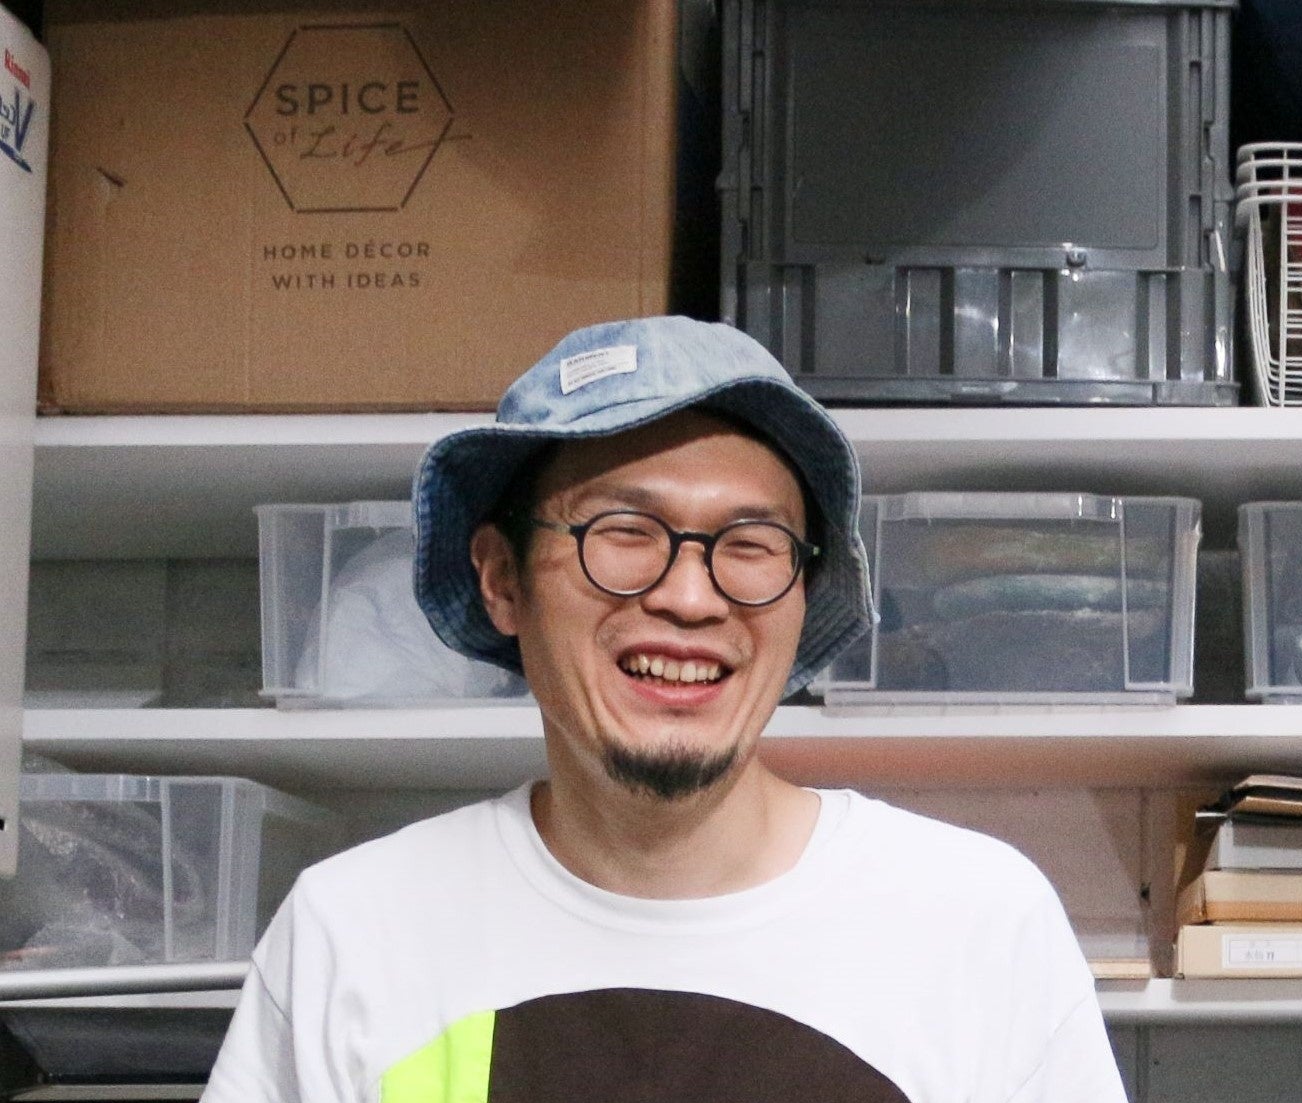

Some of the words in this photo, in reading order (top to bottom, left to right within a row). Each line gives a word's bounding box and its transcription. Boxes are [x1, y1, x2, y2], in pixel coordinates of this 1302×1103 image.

[275, 78, 421, 117] SPICE
[274, 126, 298, 146] of
[300, 121, 473, 168] Life
[263, 244, 333, 262] HOME
[345, 239, 431, 260] DÉCOR
[272, 274, 336, 291] WITH
[347, 271, 421, 290] IDEAS
